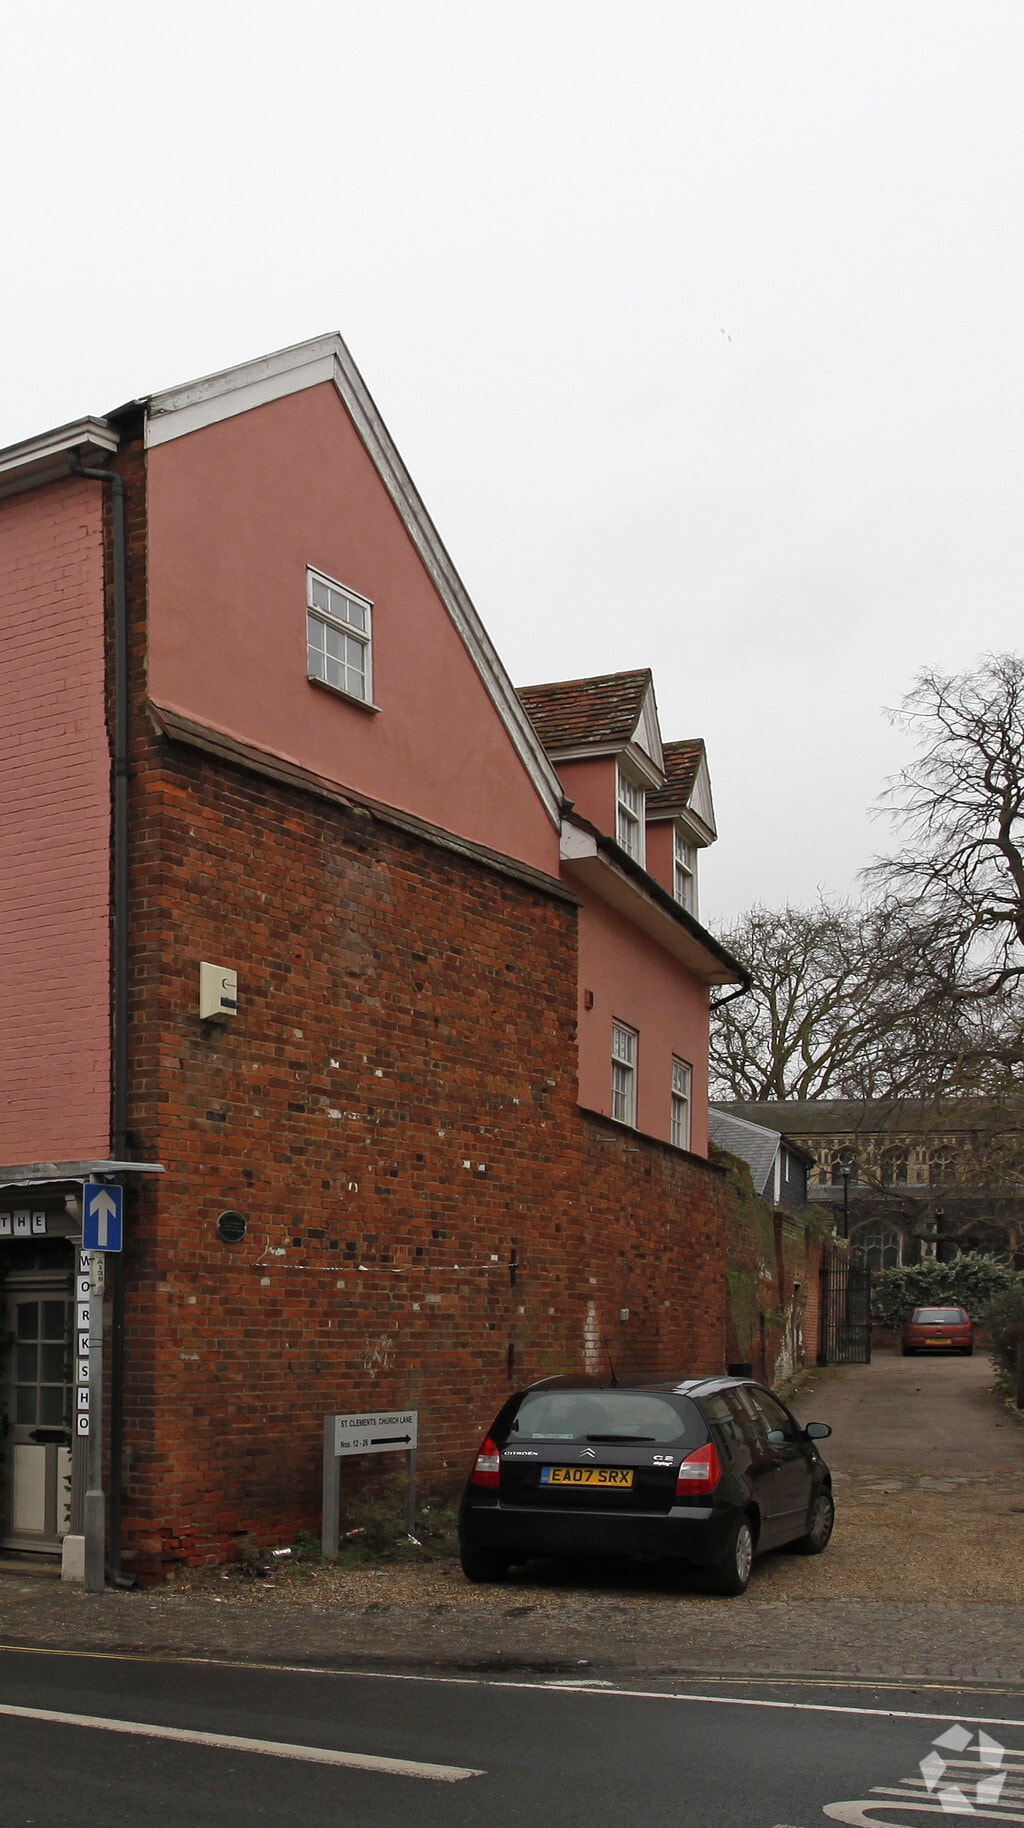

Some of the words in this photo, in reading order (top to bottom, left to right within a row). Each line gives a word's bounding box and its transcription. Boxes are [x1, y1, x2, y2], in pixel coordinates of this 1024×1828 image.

[1, 1215, 42, 1228] THE
[349, 1418, 376, 1428] CLEMENTS
[379, 1417, 399, 1425] CHURCH
[400, 1416, 413, 1424] LANE
[552, 1468, 593, 1482] EA07
[598, 1470, 630, 1484] SRX
